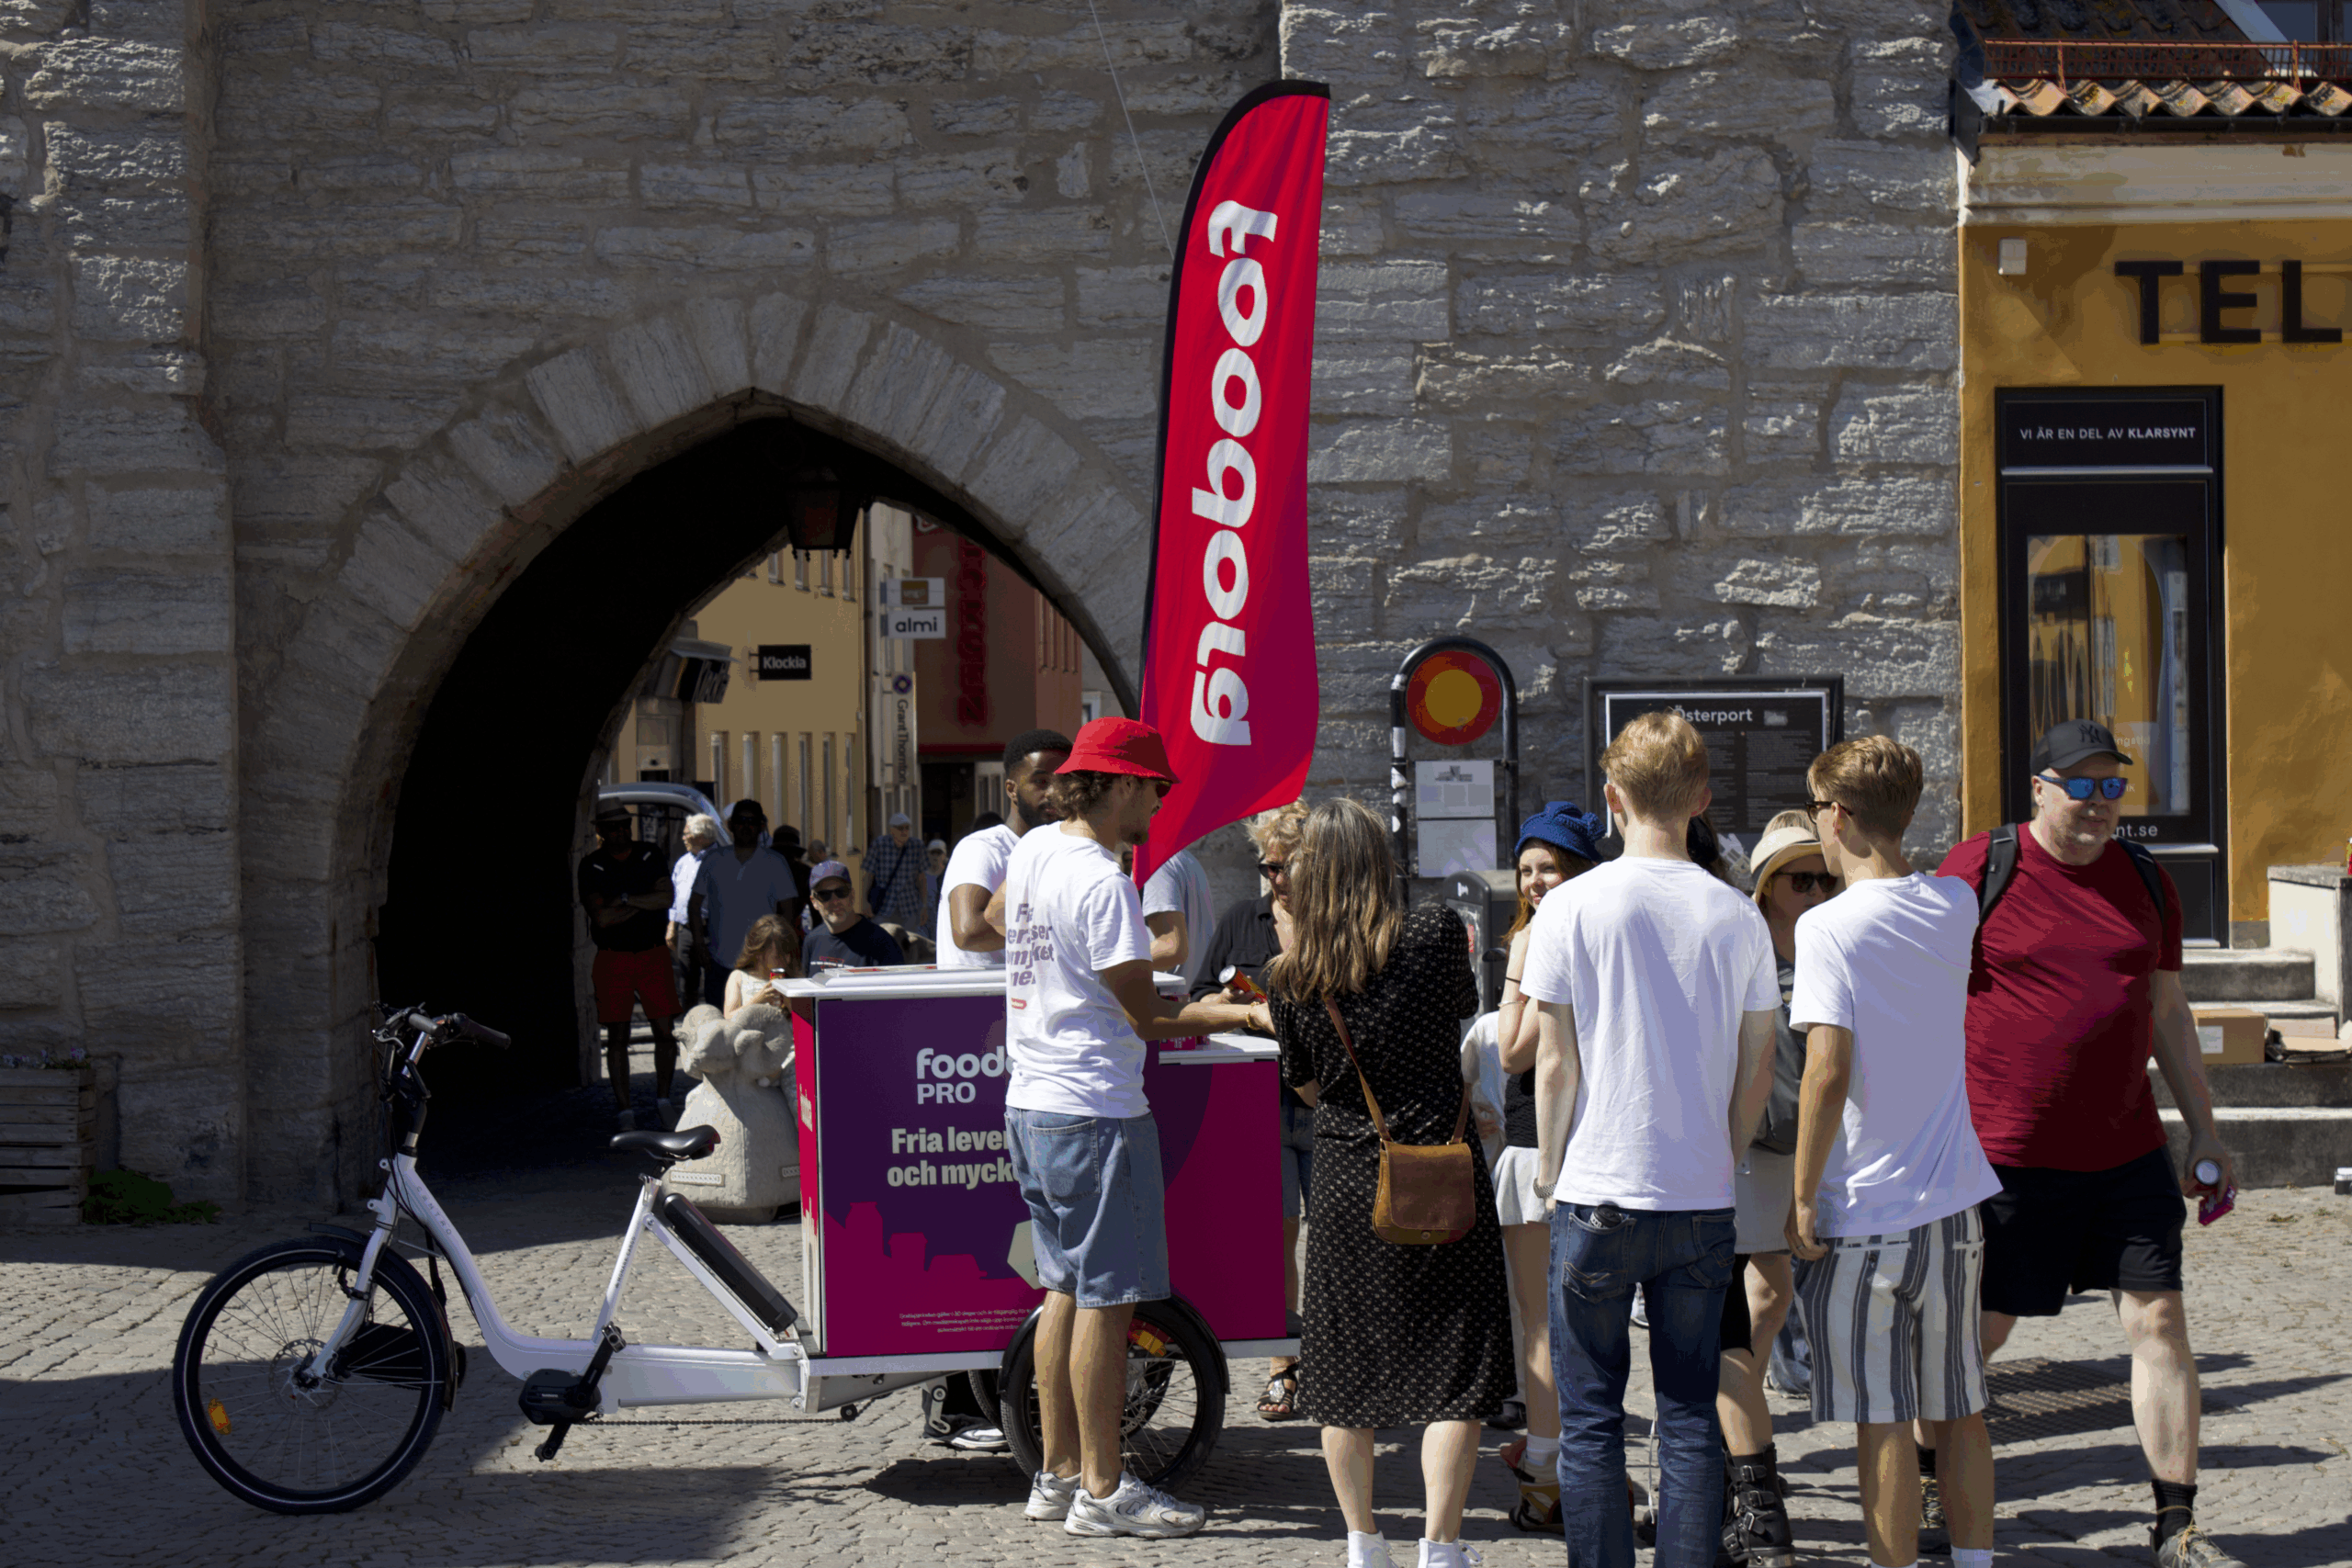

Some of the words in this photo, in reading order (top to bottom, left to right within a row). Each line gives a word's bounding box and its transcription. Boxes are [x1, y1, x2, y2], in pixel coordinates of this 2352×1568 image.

[2115, 260, 2342, 344] TEL
[2020, 429, 2032, 439] VI
[2037, 427, 2053, 439] ÄR
[2058, 429, 2075, 439] EN
[2079, 428, 2103, 439] DEL
[2108, 428, 2123, 439] AV
[2128, 426, 2196, 439] KLARSYNT
[1189, 199, 1278, 746] foodora
[895, 616, 937, 632] almi
[763, 657, 807, 669] Klockia
[1674, 705, 1753, 726] Österport
[917, 1081, 977, 1104] PRO
[891, 1127, 944, 1154] Fria
[887, 1159, 937, 1187] och
[942, 1156, 1020, 1190] myck
